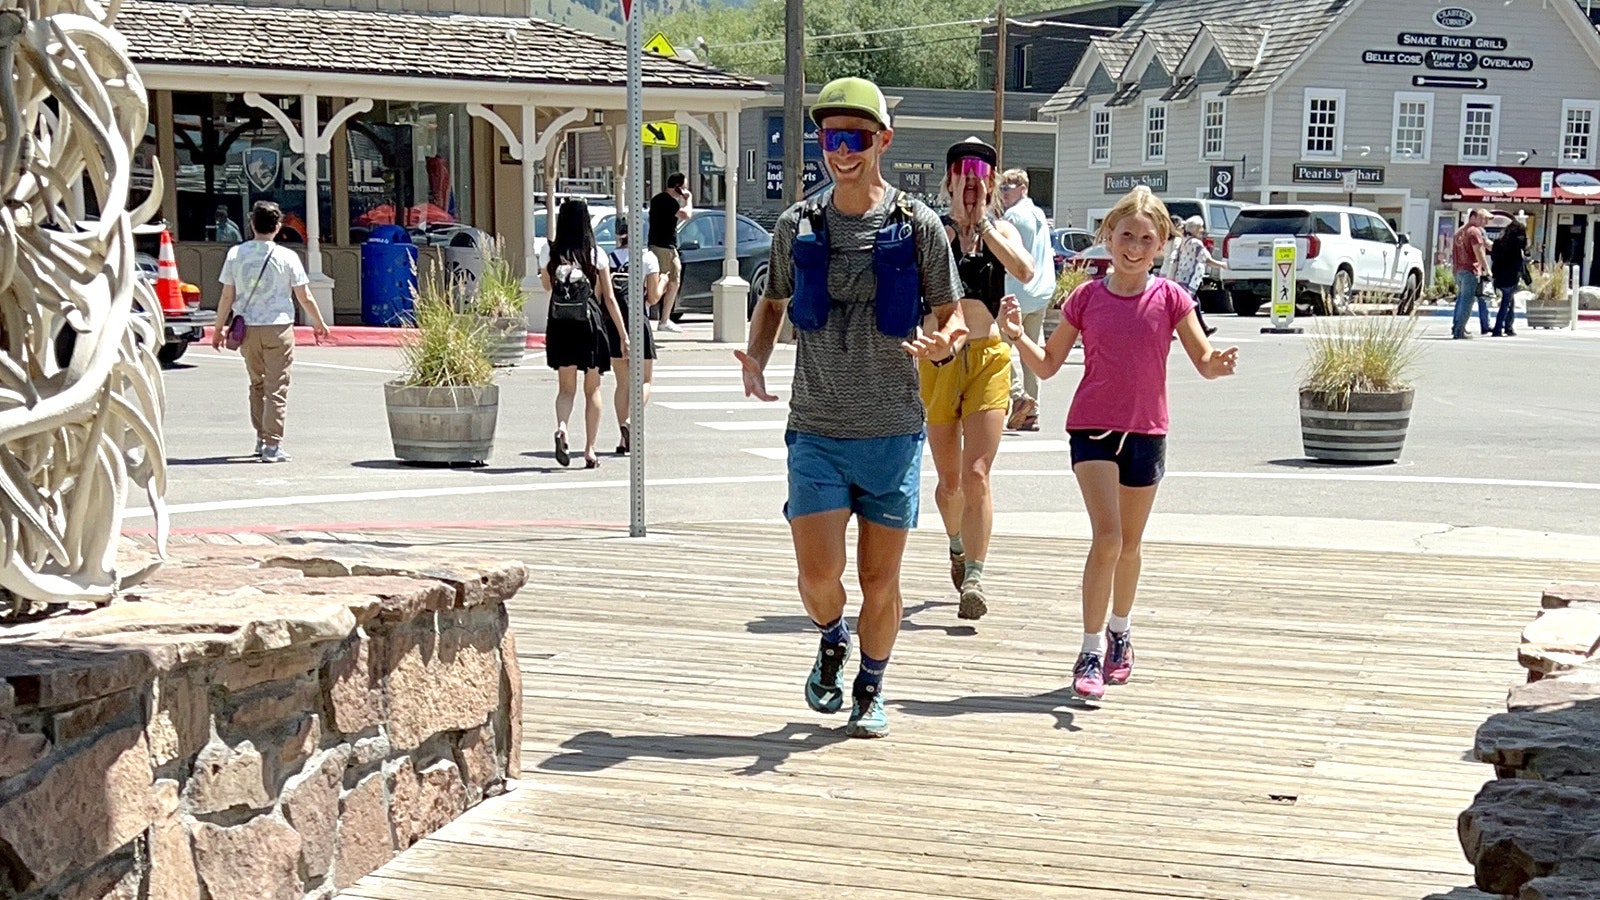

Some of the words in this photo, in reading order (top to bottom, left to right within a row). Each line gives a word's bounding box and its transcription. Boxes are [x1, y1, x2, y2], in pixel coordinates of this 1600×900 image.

[1403, 34, 1437, 46] SNAKE
[1441, 36, 1471, 48] RIVER
[1475, 38, 1504, 49] GRILL
[1365, 52, 1395, 63] BELLE
[1397, 53, 1422, 64] COSE
[1431, 51, 1455, 62] YIPPY
[1433, 60, 1455, 68] CANDY
[1482, 57, 1531, 69] OVERLAND
[1299, 168, 1332, 178] Pearls
[767, 181, 774, 190] &
[1106, 176, 1130, 189] Pearls
[1142, 174, 1163, 187] Shari
